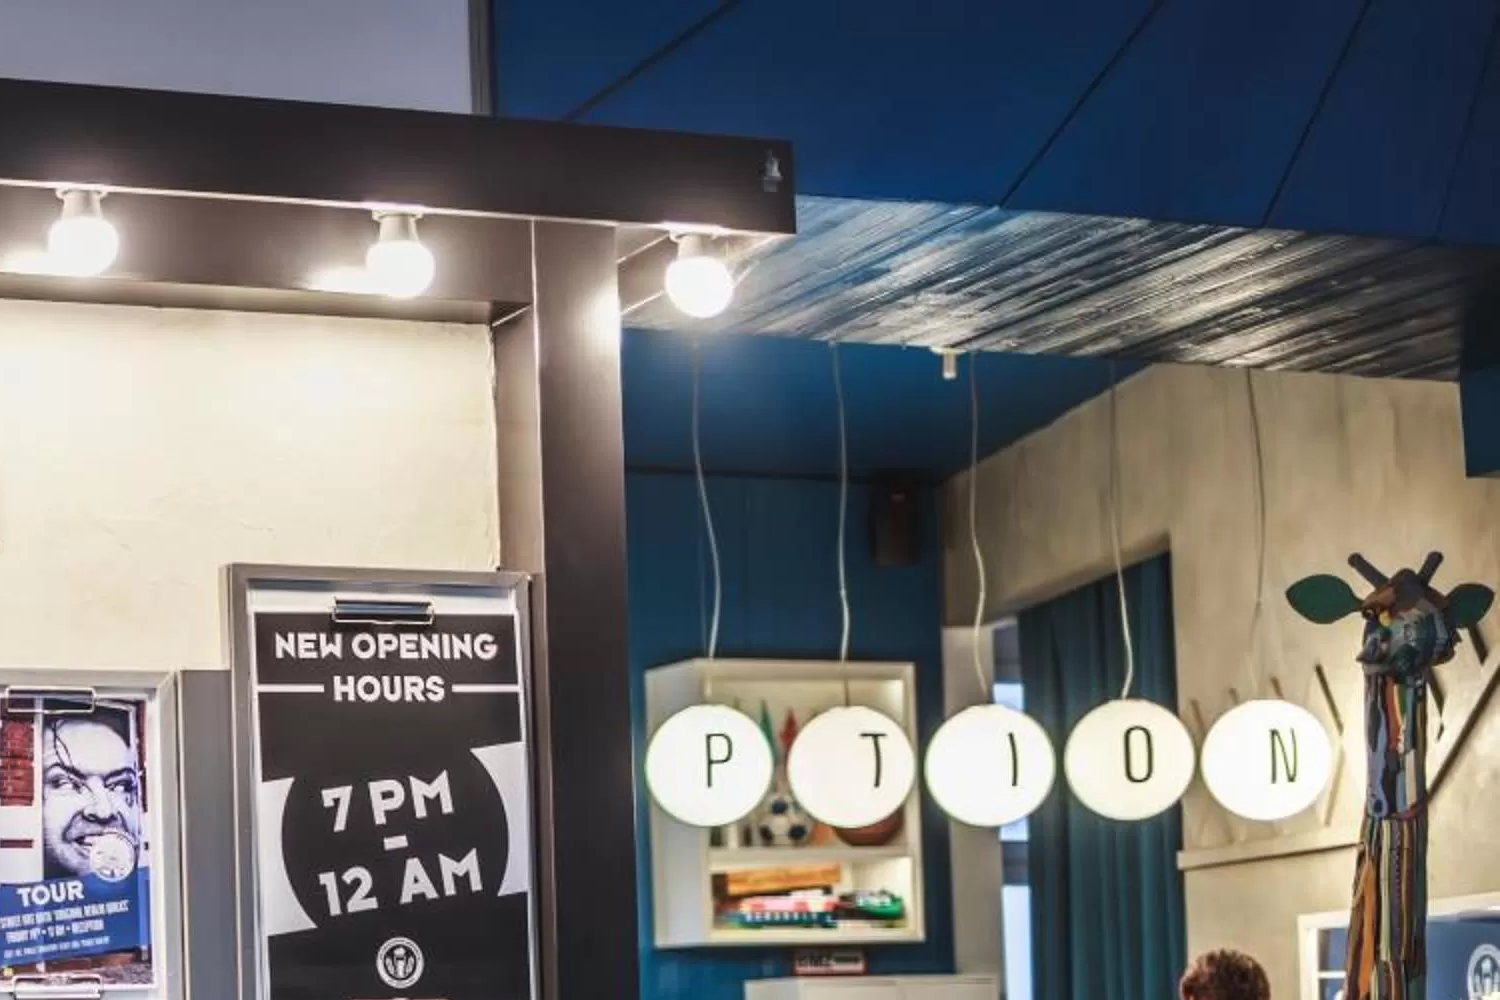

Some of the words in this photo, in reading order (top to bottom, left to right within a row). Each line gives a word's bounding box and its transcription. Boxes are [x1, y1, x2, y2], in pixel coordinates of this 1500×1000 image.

[276, 632, 342, 659] NEW
[352, 632, 498, 660] OPENING
[332, 675, 445, 702] HOURS
[17, 881, 84, 907] TOUR
[319, 866, 379, 916] 12
[400, 848, 483, 905] AM
